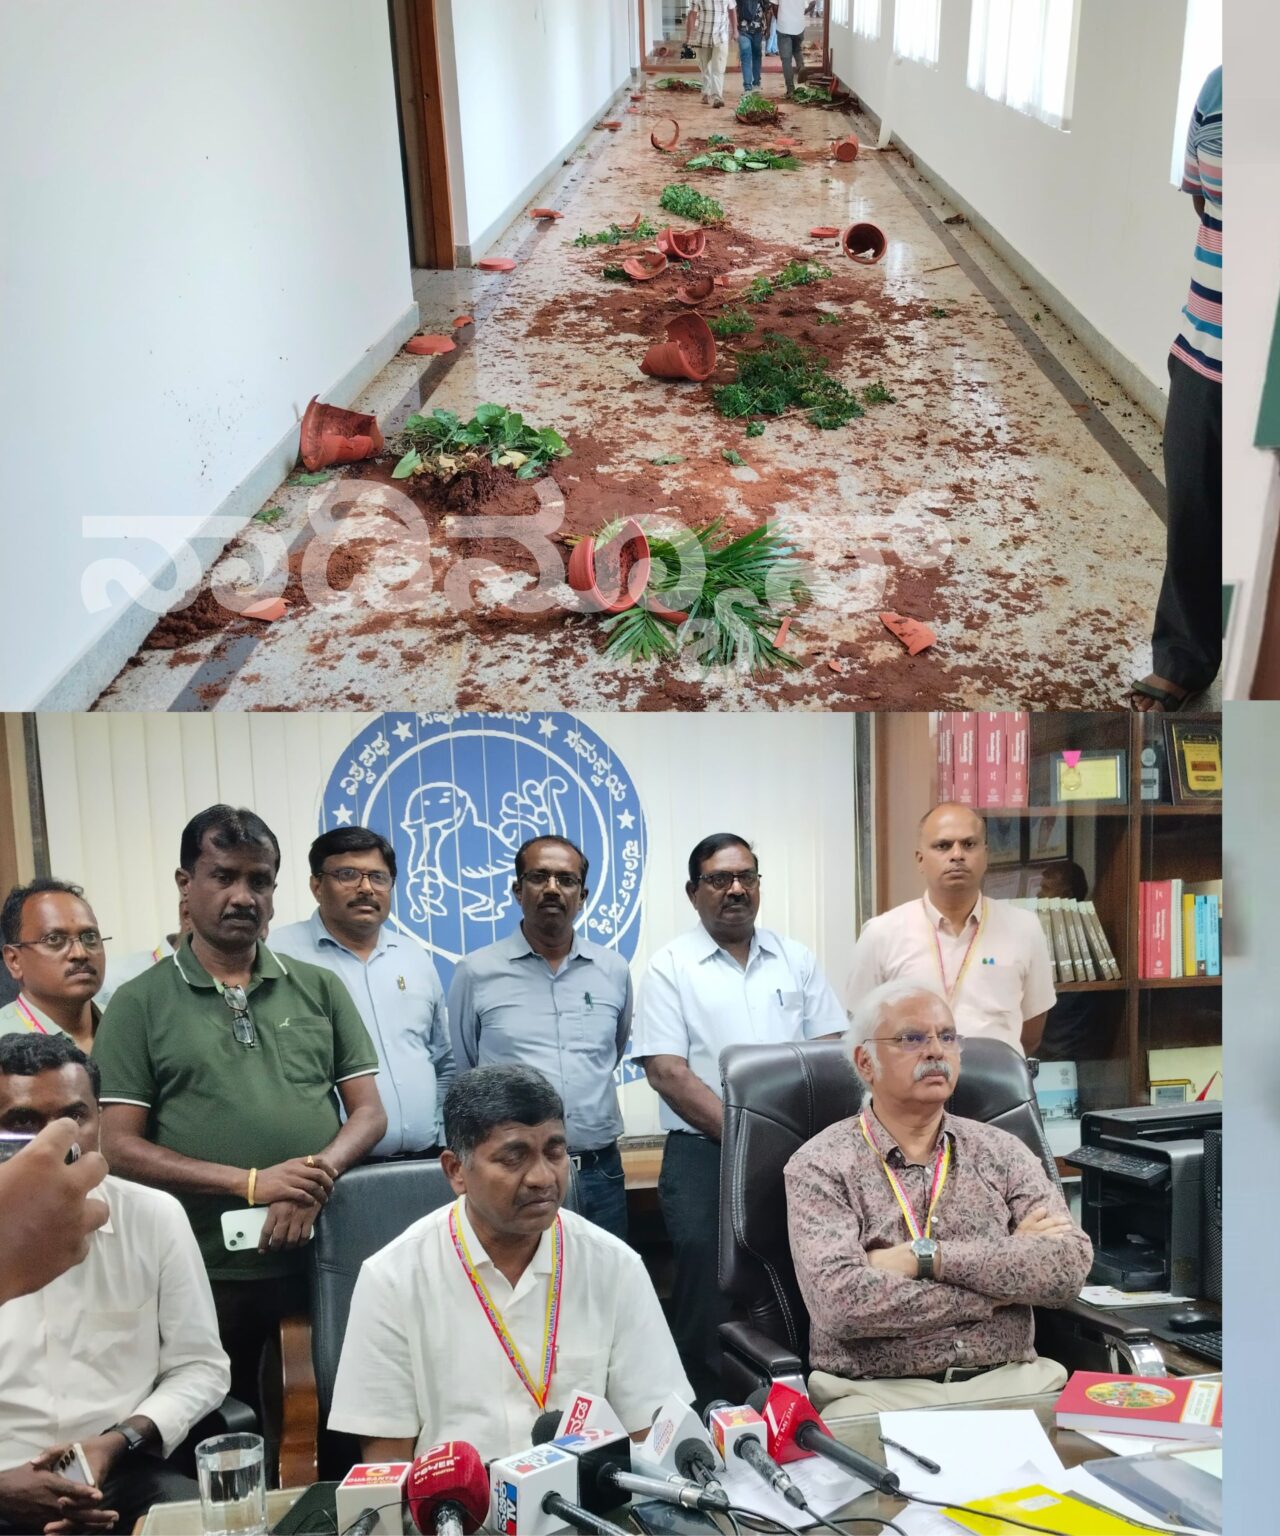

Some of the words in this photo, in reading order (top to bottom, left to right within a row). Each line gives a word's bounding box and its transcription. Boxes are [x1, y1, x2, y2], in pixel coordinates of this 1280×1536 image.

[780, 1402, 796, 1433] MEDIA
[414, 1459, 455, 1480] POWER
[506, 1497, 516, 1520] TV
